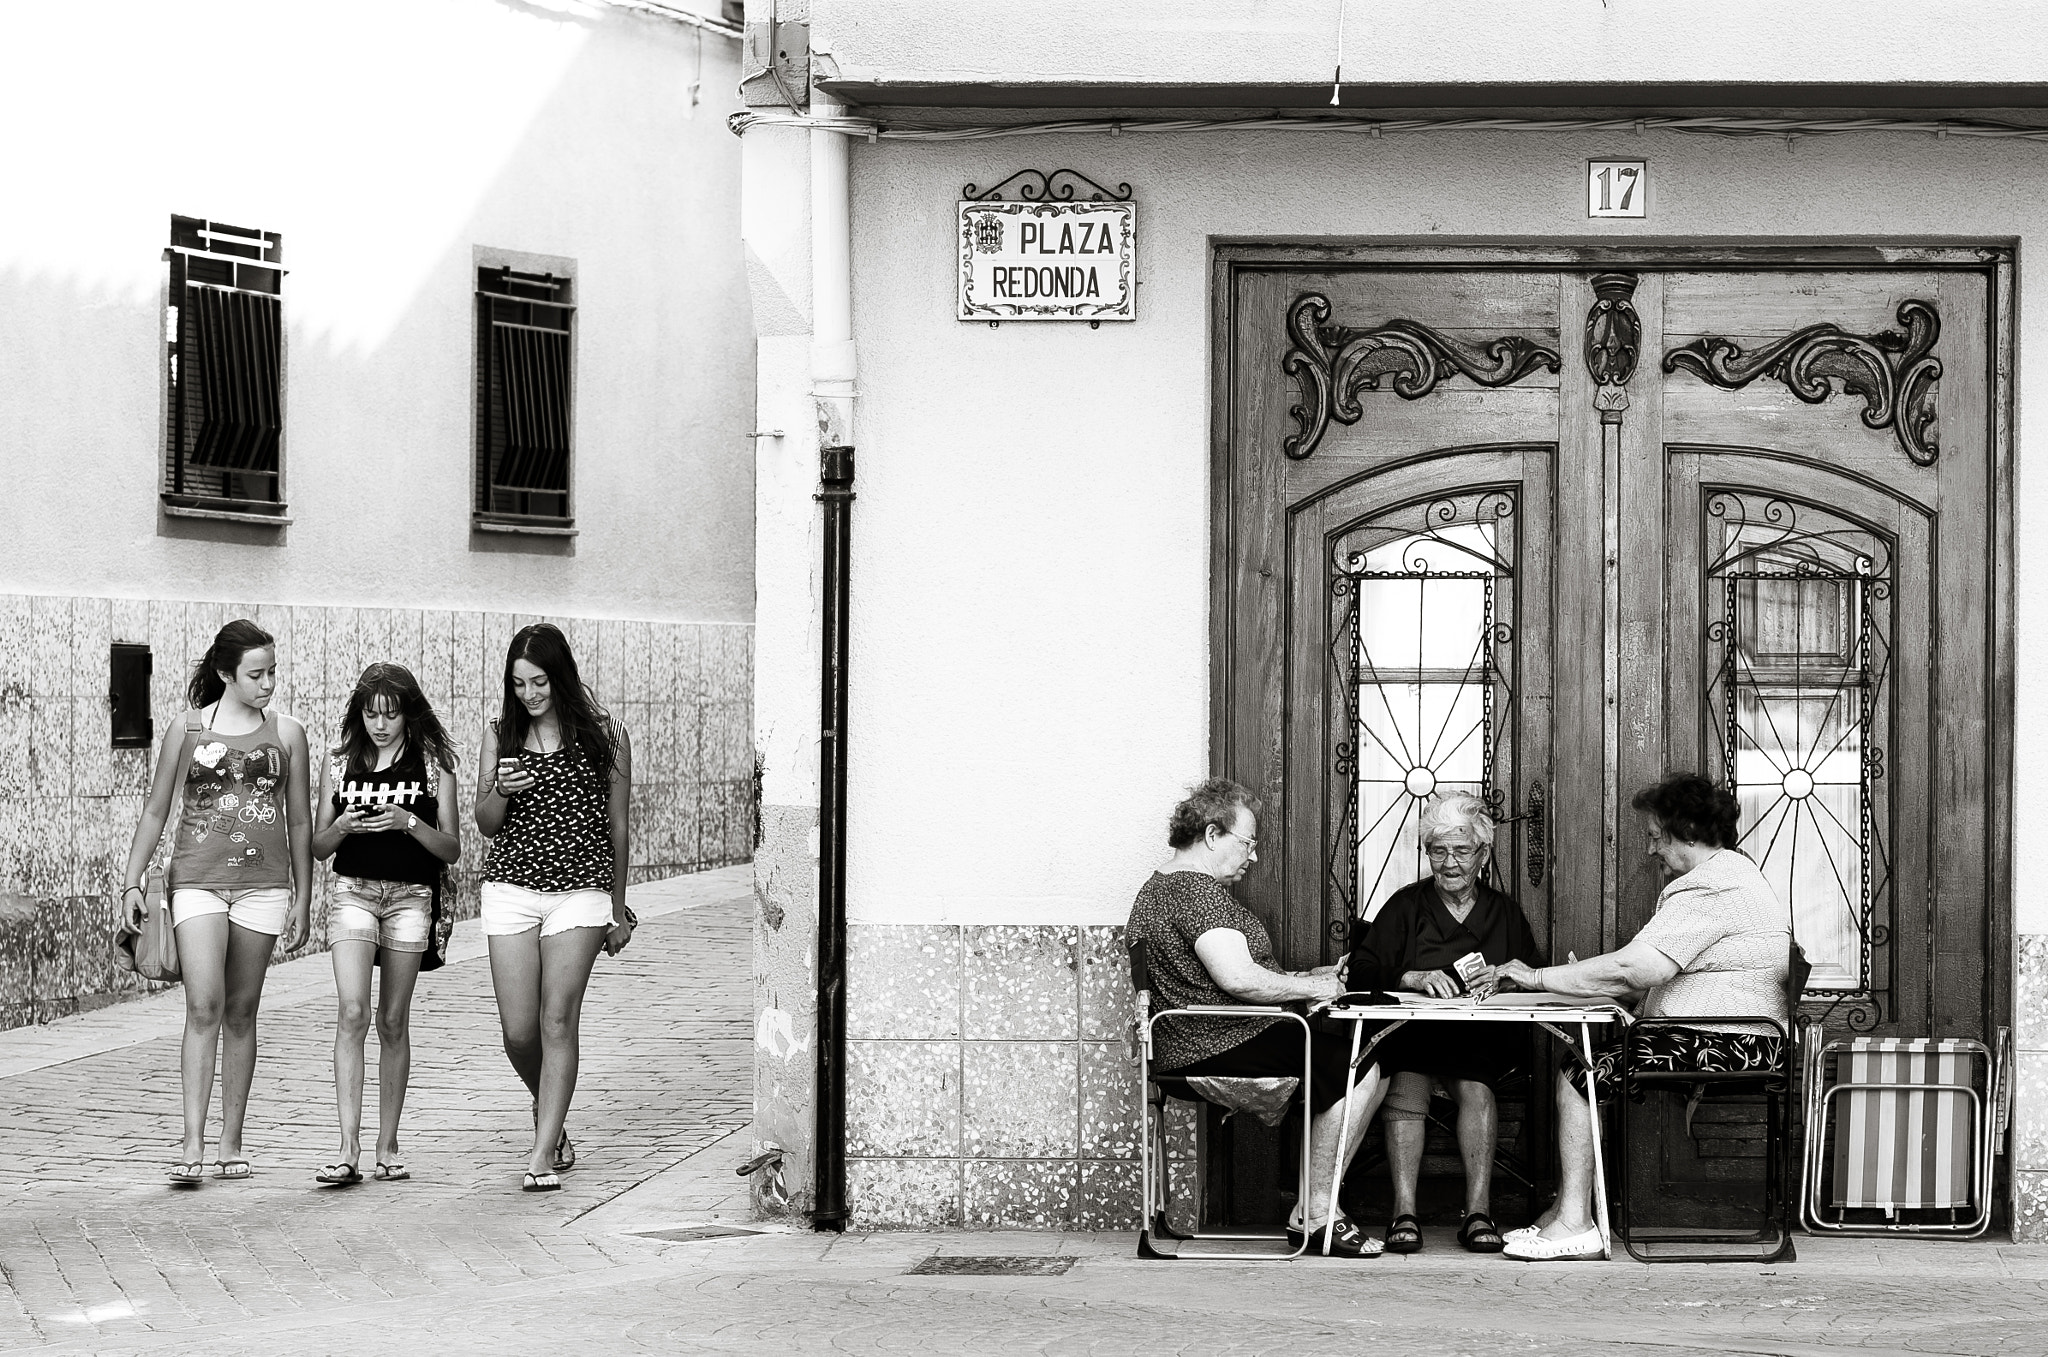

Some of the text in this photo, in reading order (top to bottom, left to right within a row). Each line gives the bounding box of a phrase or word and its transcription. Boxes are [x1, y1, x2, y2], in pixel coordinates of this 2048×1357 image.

[1597, 167, 1639, 210] 17
[1021, 222, 1114, 254] PLAZA
[993, 266, 1100, 298] REDONDA
